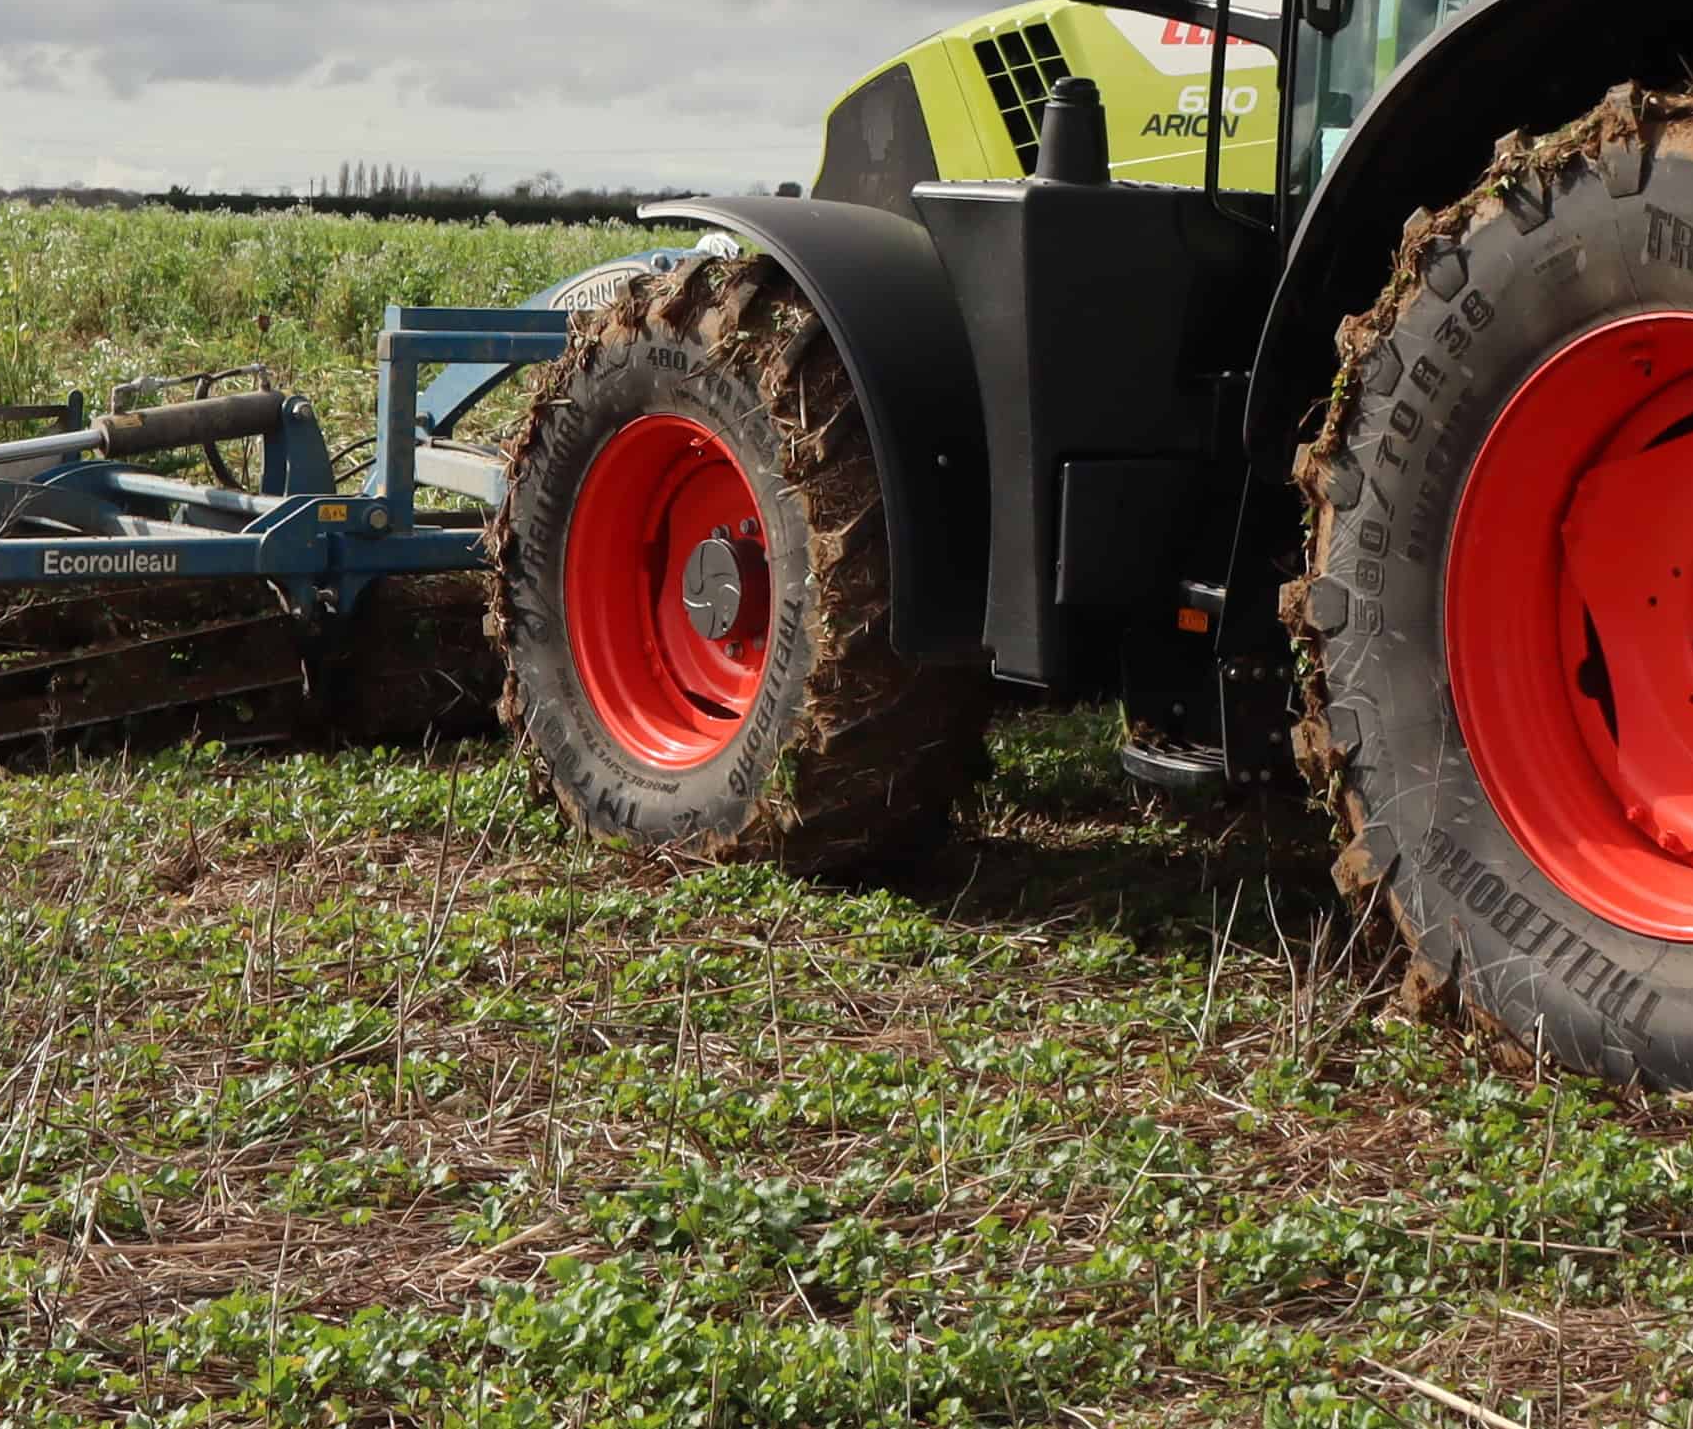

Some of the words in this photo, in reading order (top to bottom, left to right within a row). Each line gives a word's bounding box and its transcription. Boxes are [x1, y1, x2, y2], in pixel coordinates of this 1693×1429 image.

[43, 550, 178, 575] Ecorouleau
[727, 598, 803, 798] TRELLEBORG
[1411, 827, 1662, 1049] TRELLEBORG
